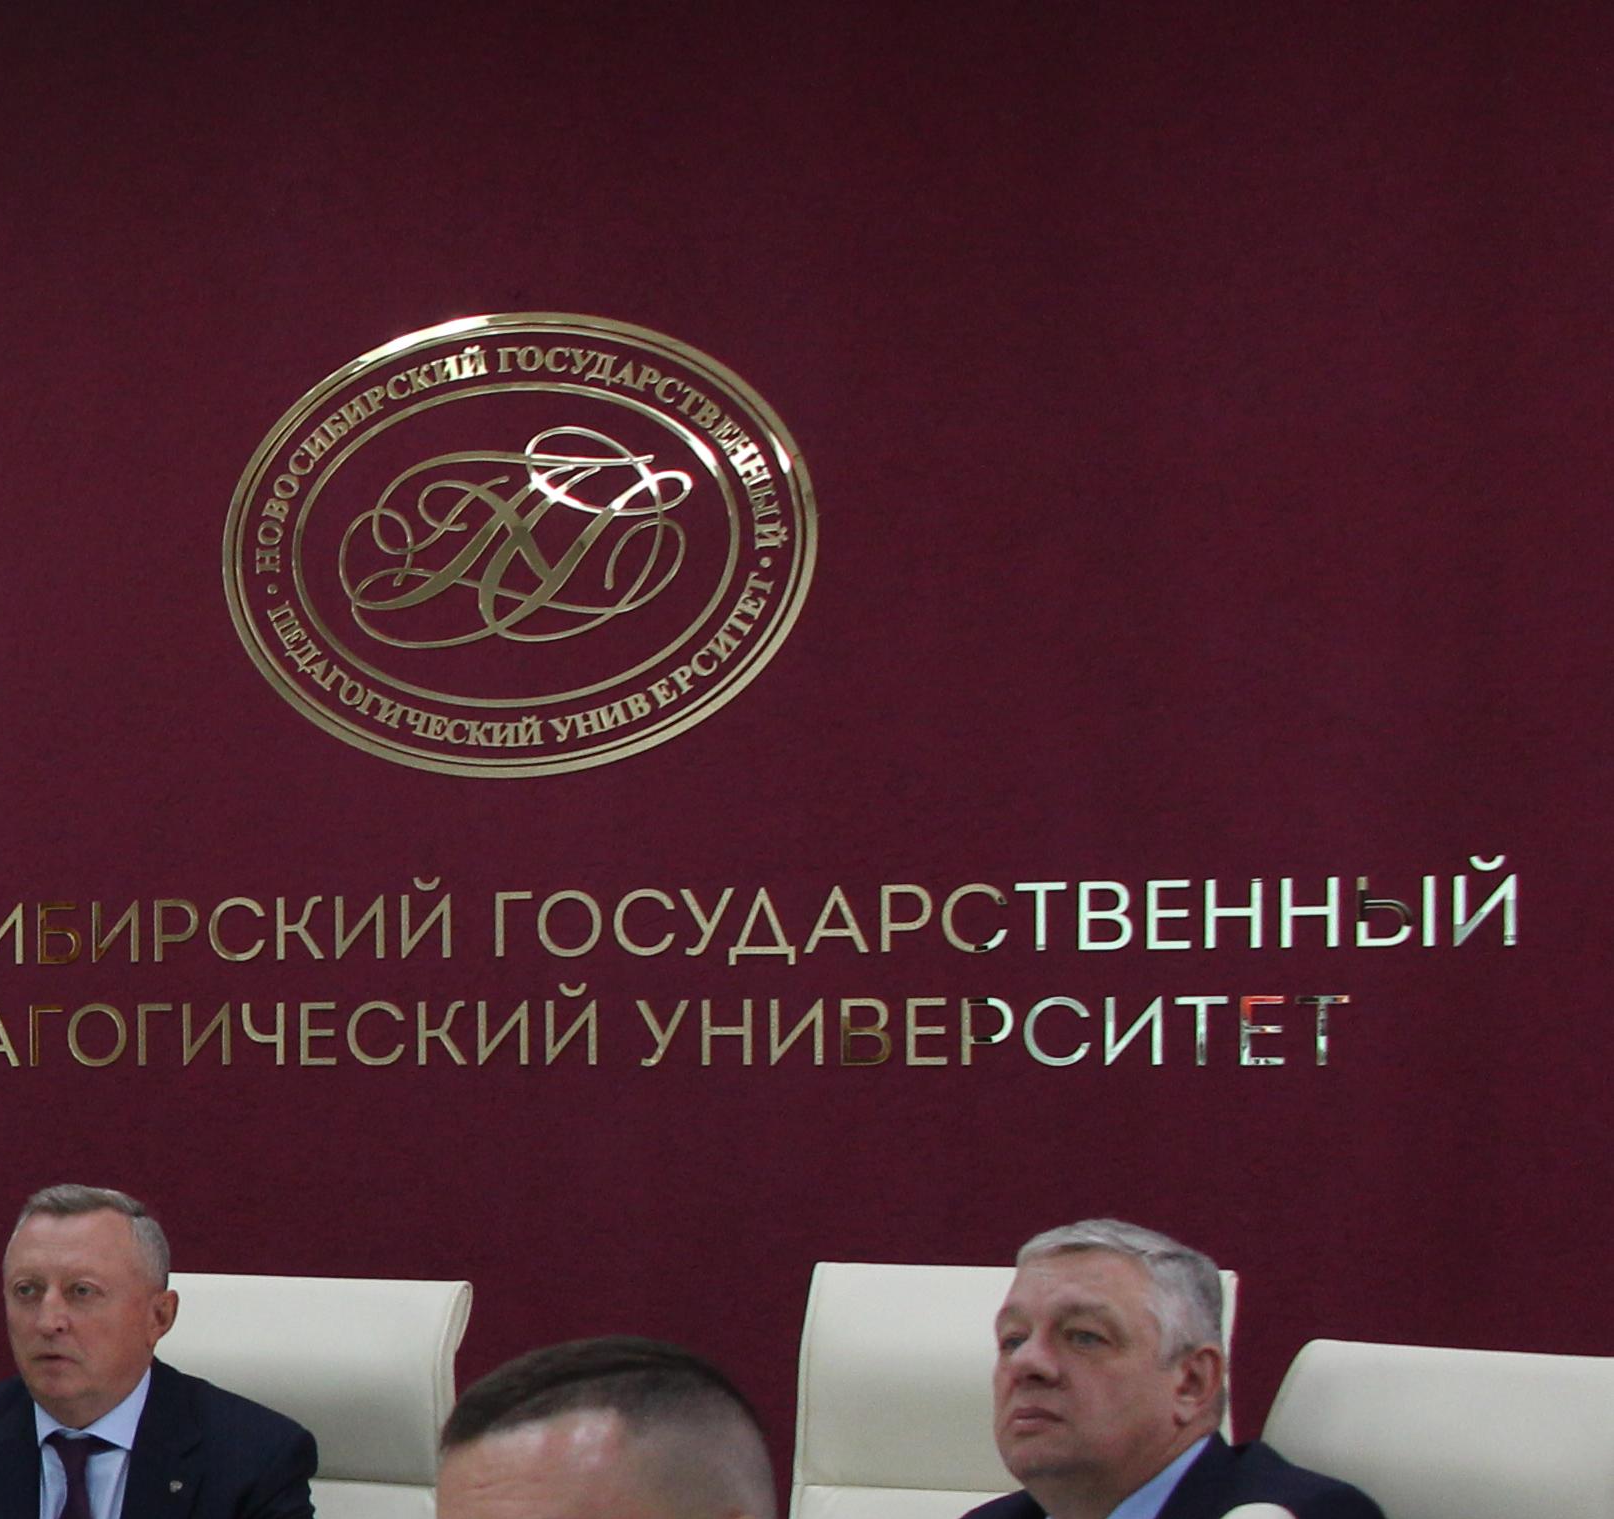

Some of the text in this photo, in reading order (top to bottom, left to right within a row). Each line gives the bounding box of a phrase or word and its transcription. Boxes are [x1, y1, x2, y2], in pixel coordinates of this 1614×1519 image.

[255, 344, 490, 574] НОВОСИБИРСКИЙ
[497, 345, 789, 550] ГОСУДАРСТВЕННЫЙ
[267, 599, 544, 748] ПЕДАГОГИЧЕСКИЙ
[494, 854, 1519, 966] ГОСУДАРСТВЕННЫЙ
[634, 994, 1350, 1069] УНИВЕРСИТЕТ
